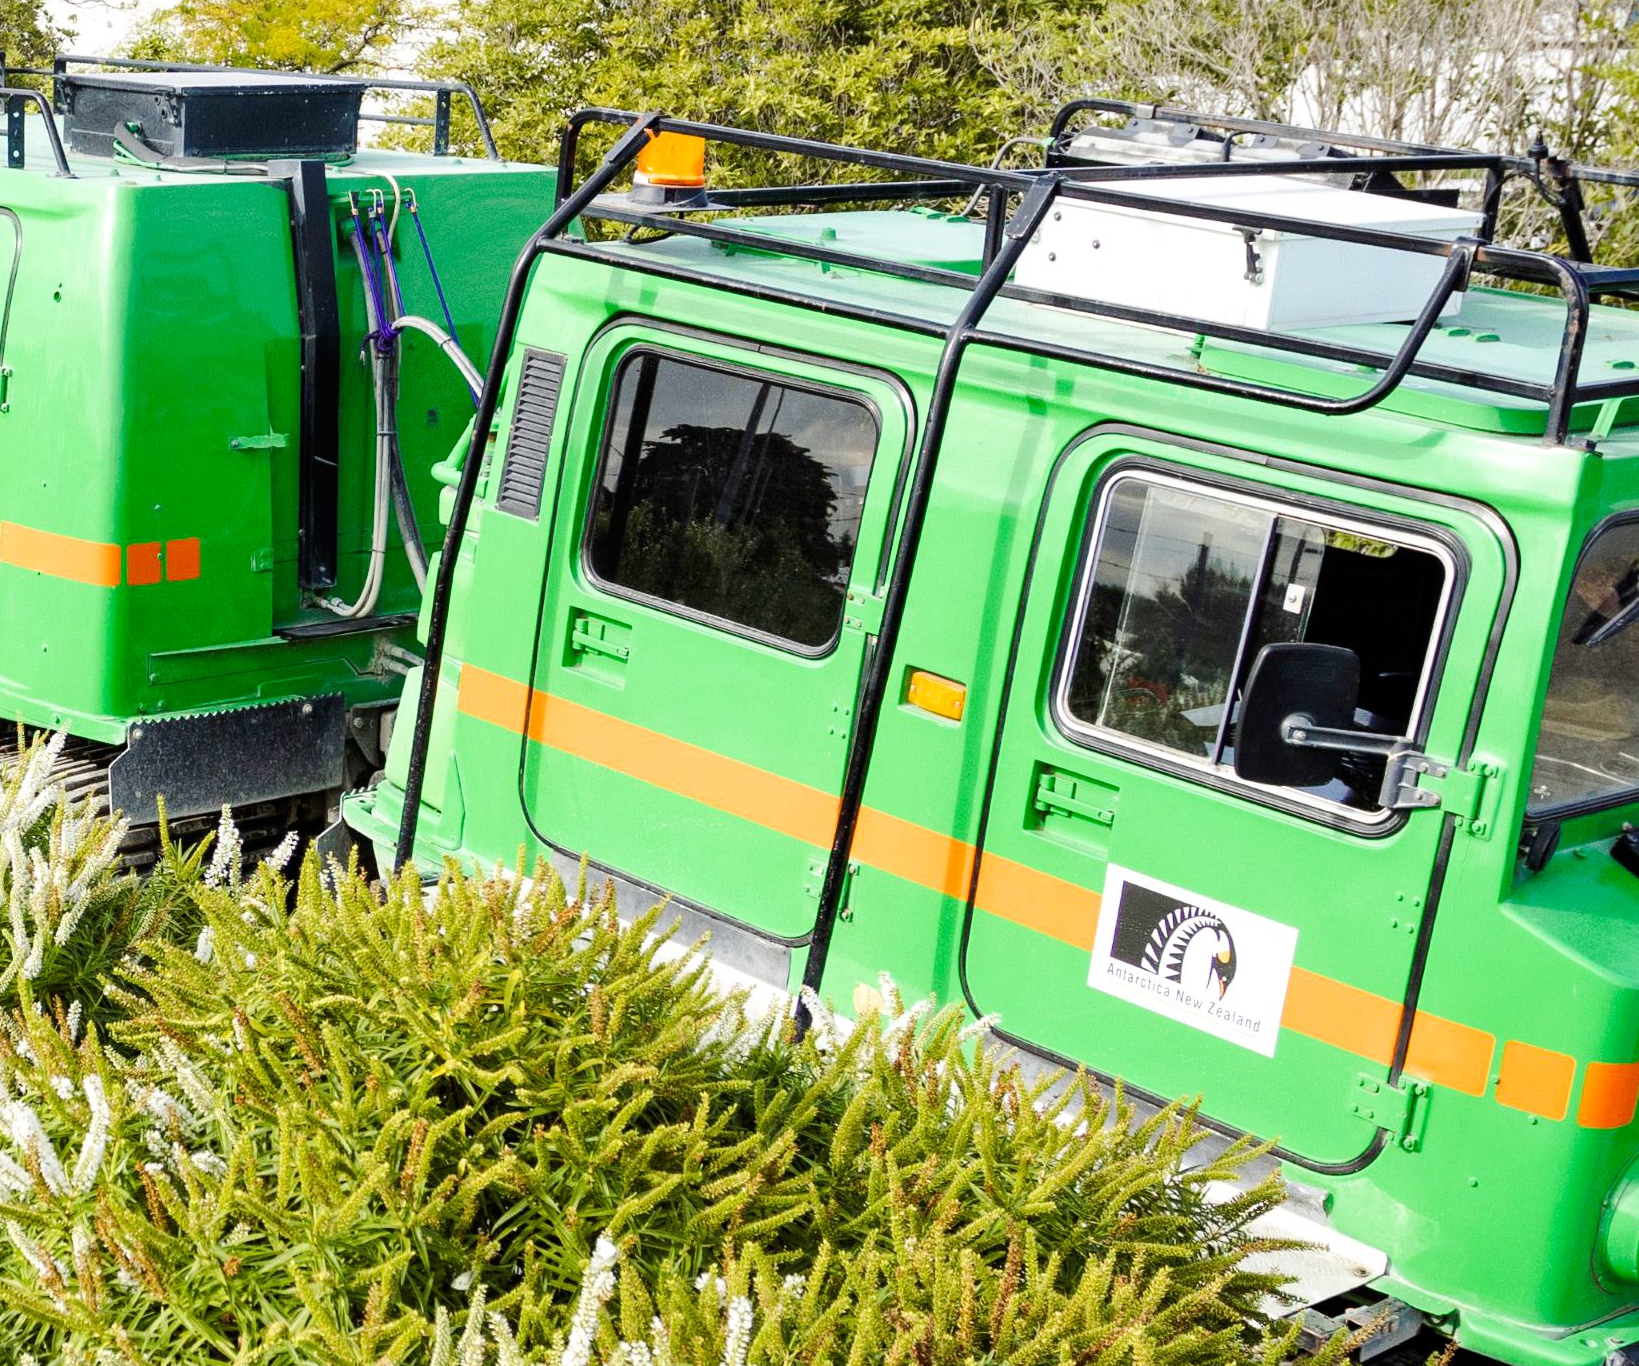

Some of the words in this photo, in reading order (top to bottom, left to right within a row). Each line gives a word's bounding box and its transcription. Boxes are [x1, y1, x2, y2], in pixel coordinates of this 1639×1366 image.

[1106, 962, 1170, 998] Antarctica
[1176, 989, 1203, 1010] New
[1207, 1001, 1261, 1033] Zealand
